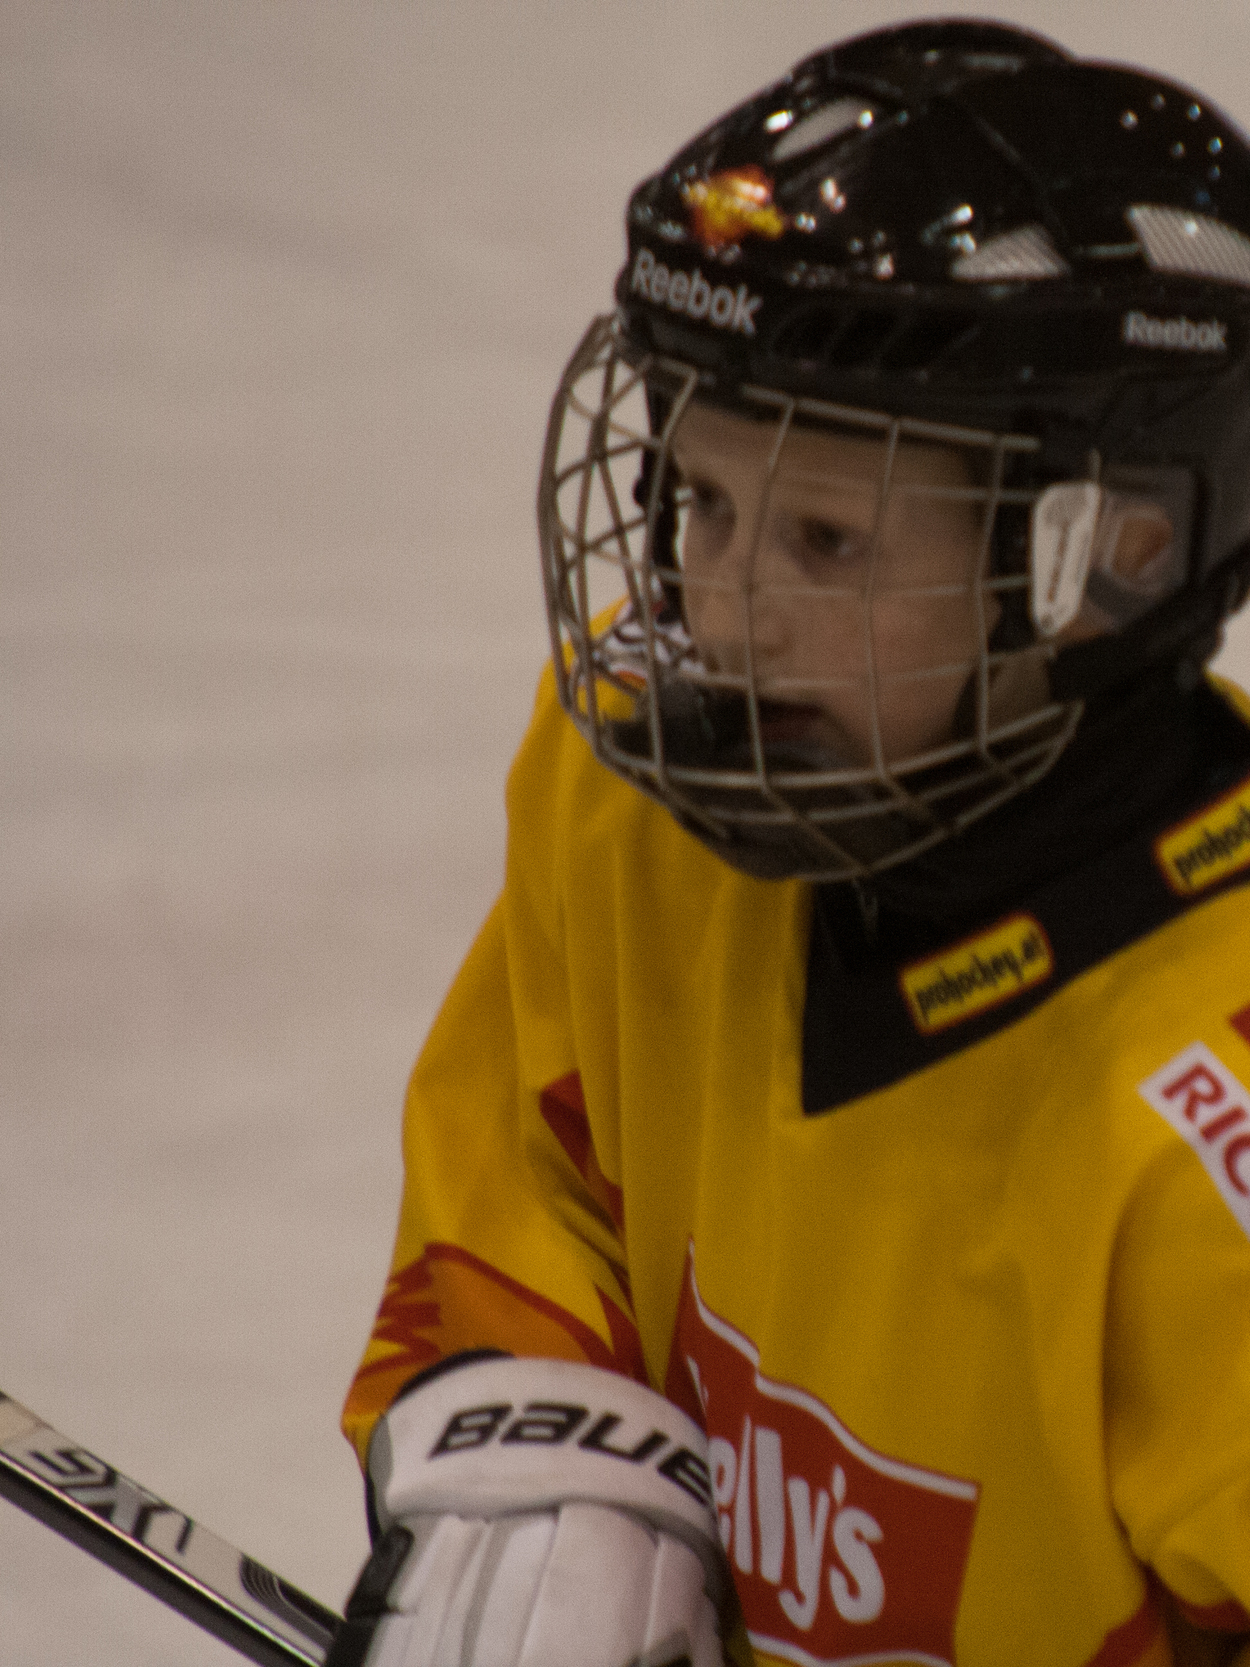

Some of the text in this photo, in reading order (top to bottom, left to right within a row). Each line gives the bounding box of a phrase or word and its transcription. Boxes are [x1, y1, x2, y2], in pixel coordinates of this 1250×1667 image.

[629, 247, 762, 335] Reebok
[1123, 311, 1228, 353] Reebok
[687, 1354, 886, 1633] elly's
